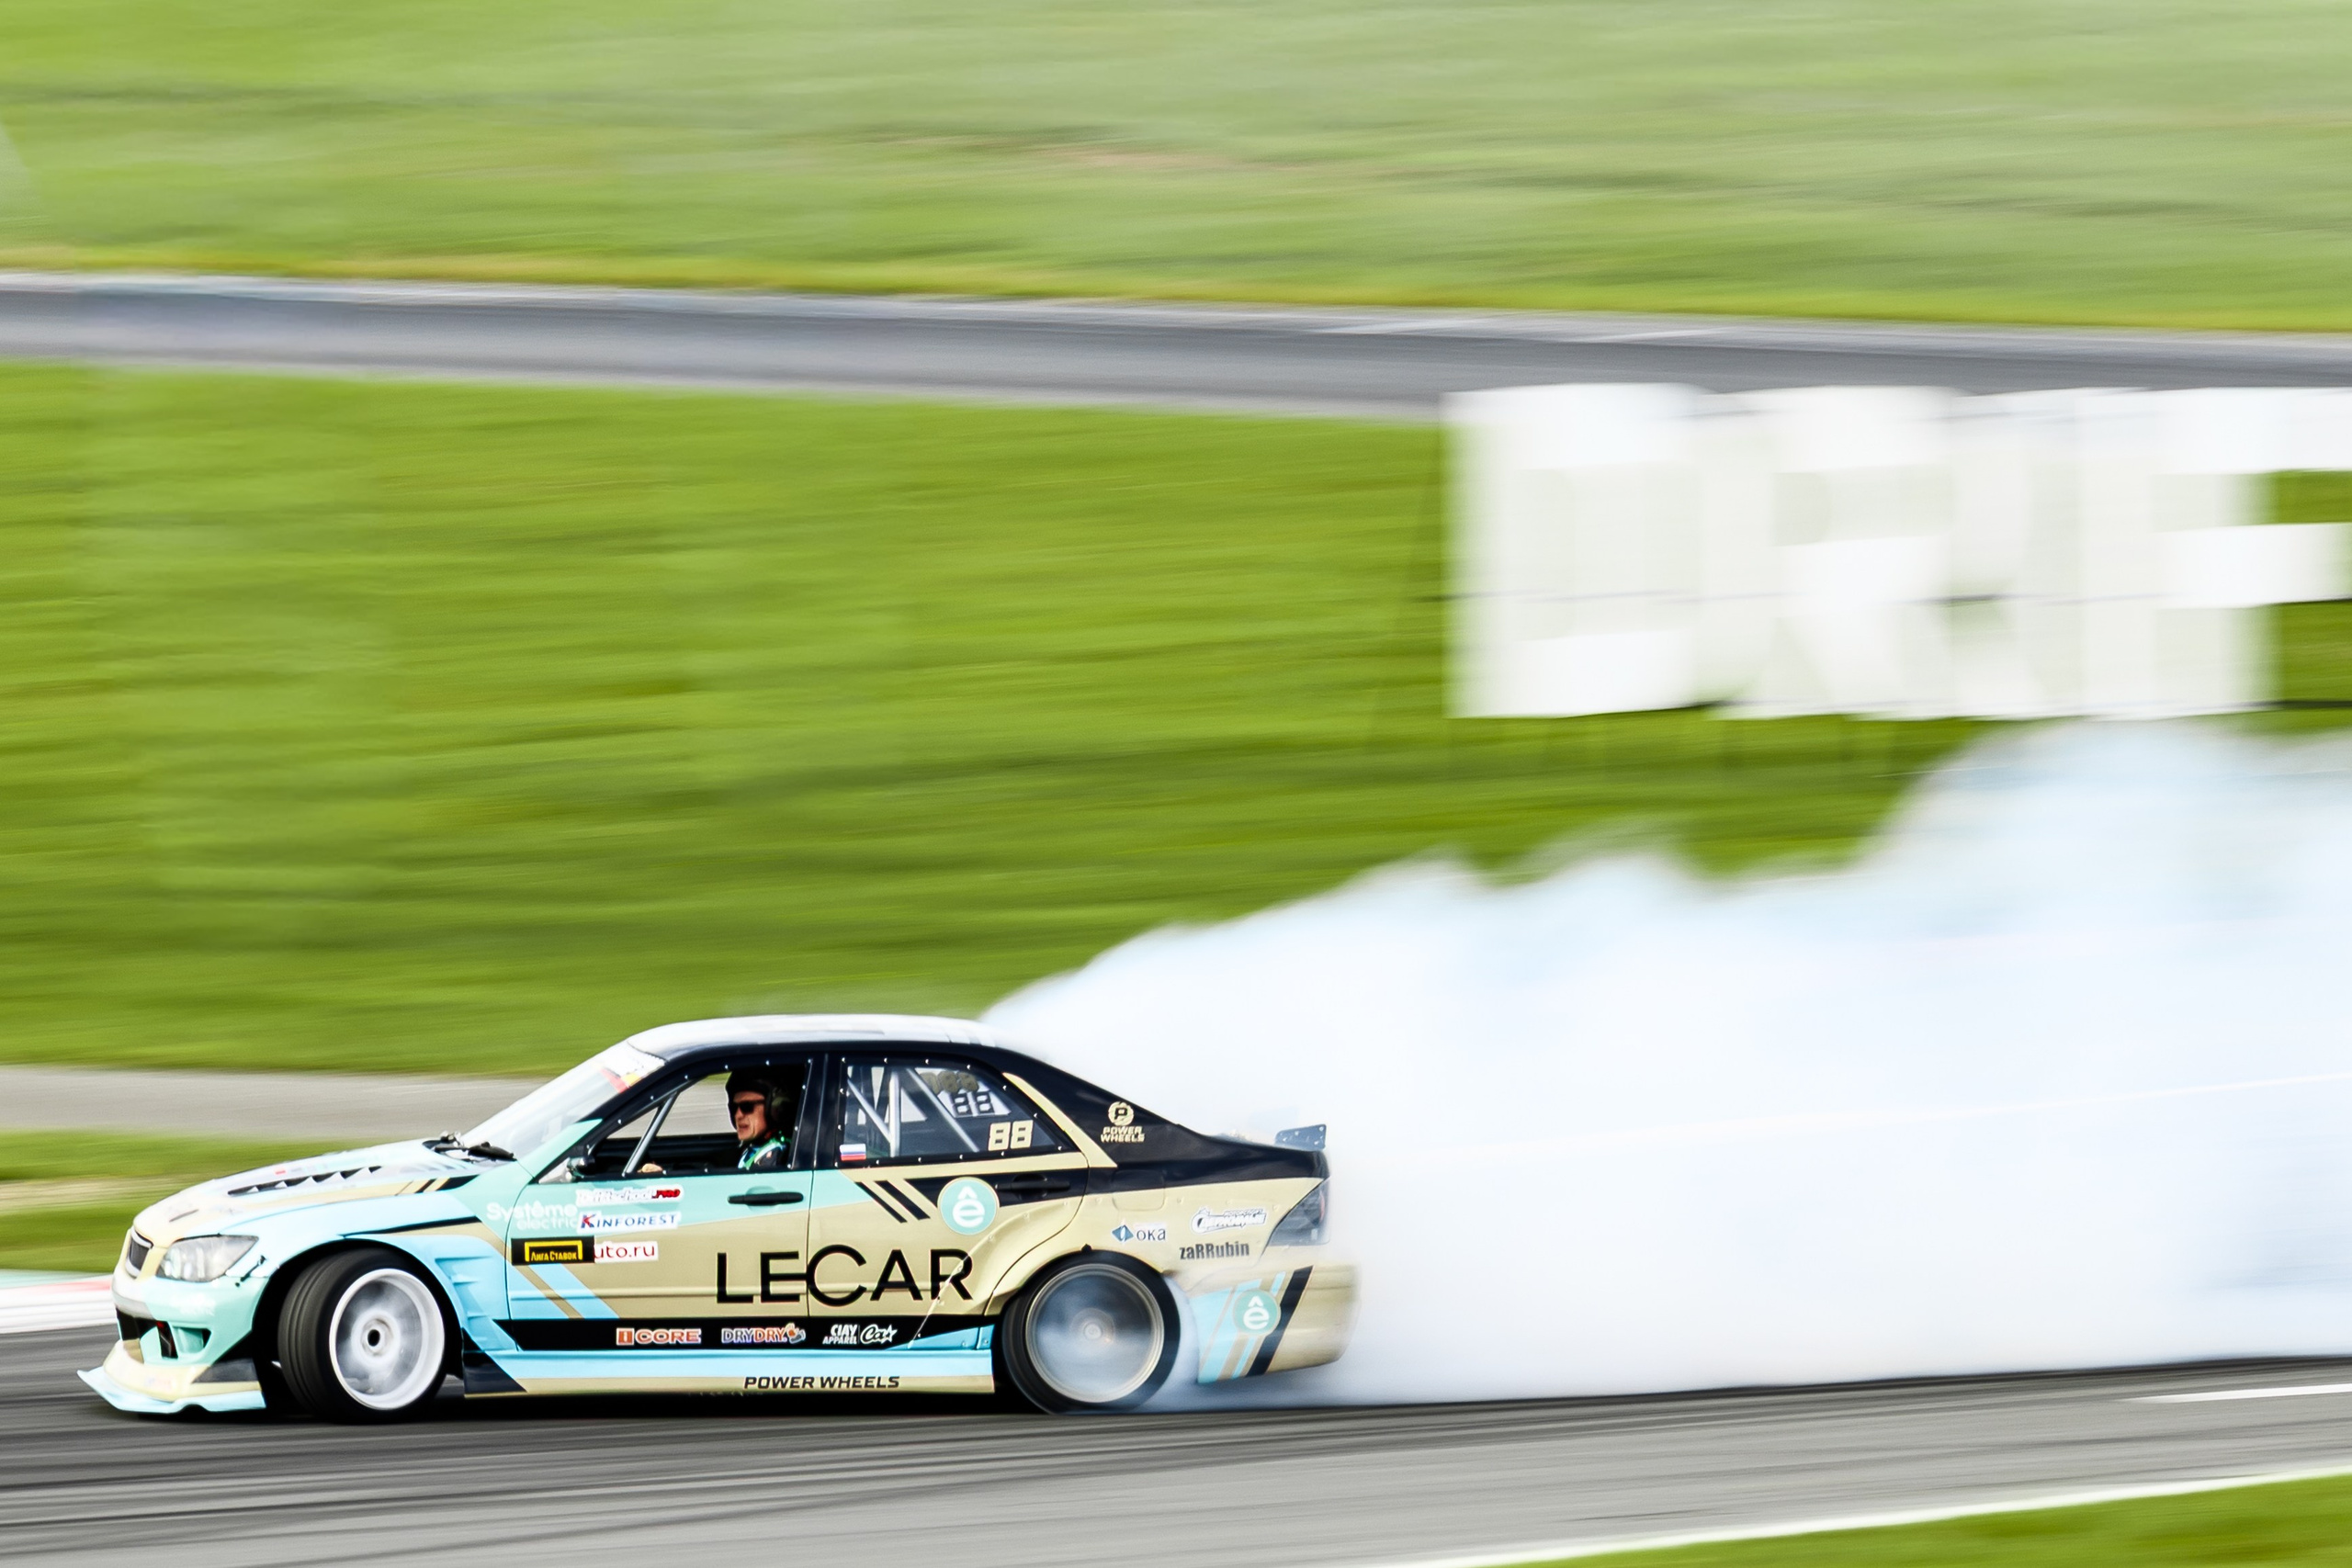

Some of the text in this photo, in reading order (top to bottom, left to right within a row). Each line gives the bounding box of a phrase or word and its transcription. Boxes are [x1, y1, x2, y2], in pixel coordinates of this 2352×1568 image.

[988, 1120, 1034, 1151] 88
[1102, 1126, 1143, 1135] POWER
[1100, 1134, 1146, 1144] WHEELS
[581, 1213, 678, 1229] KINFOREST
[594, 1246, 656, 1259] uto.ru
[1179, 1241, 1250, 1260] zaRRubin
[717, 1245, 973, 1307] LECAR
[721, 1327, 787, 1344] DRYDRY
[822, 1336, 857, 1345] APPAREL
[743, 1376, 900, 1389] POWER WHEELS
